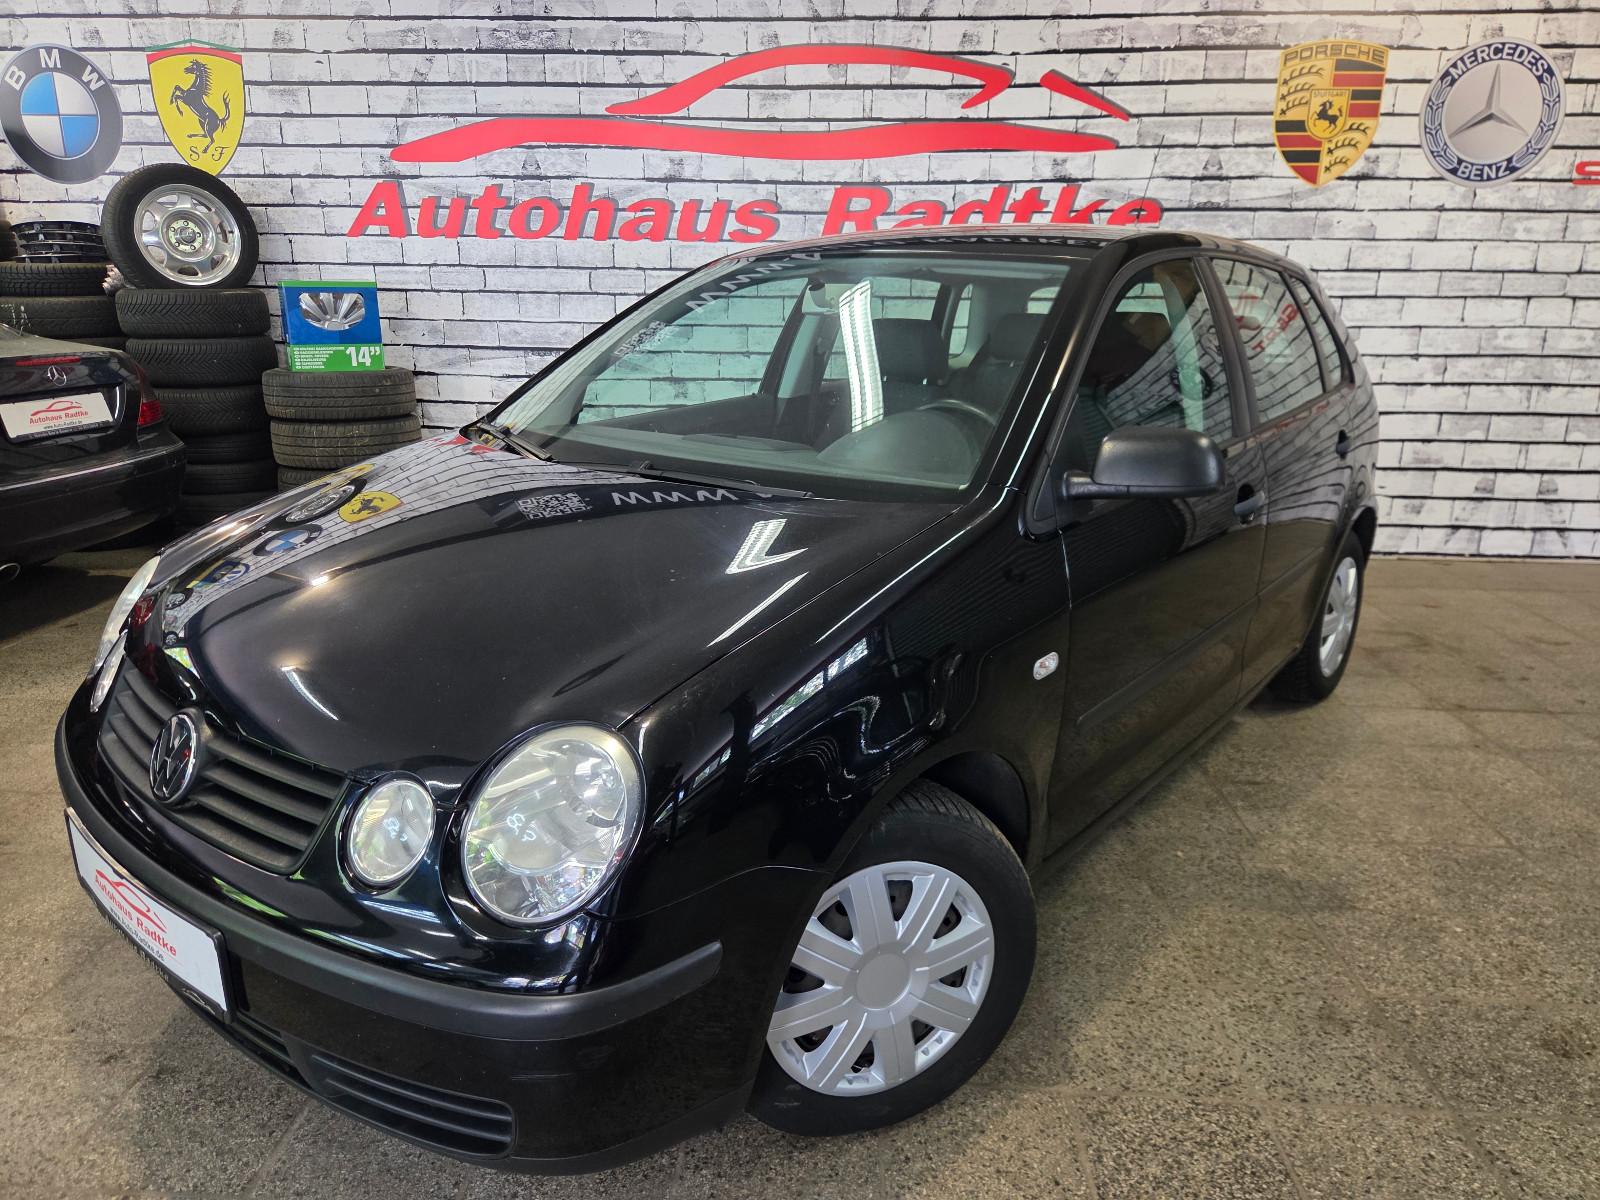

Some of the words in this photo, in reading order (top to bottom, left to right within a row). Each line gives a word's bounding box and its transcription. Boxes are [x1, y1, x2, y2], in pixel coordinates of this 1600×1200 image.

[4, 48, 106, 92] BMW
[1283, 43, 1386, 66] PORSCHE
[1451, 42, 1549, 79] MERCEDES
[1457, 160, 1511, 181] BENZ
[347, 179, 781, 243] Autohaus
[821, 182, 1164, 237] Radtke
[29, 414, 63, 425] Autohaus
[94, 873, 133, 921] Autohaus
[136, 917, 177, 957] Radtke
